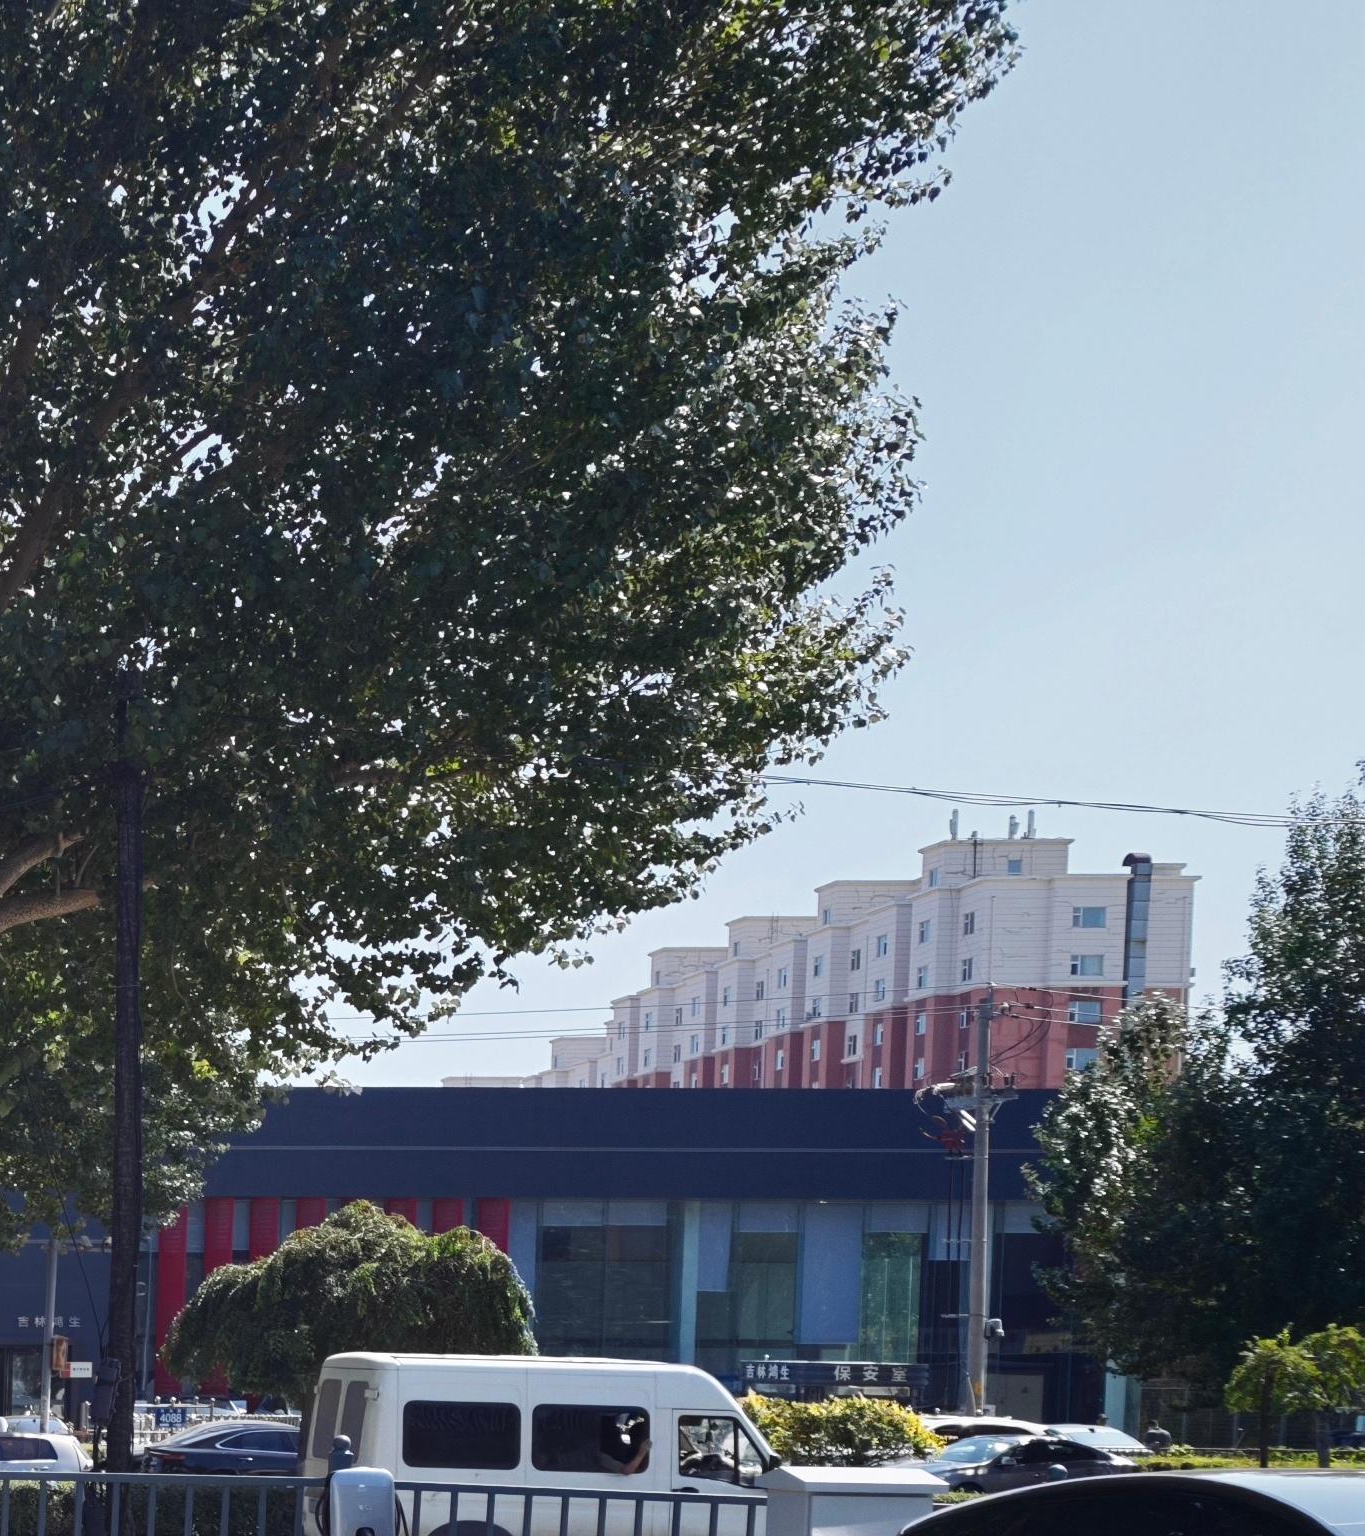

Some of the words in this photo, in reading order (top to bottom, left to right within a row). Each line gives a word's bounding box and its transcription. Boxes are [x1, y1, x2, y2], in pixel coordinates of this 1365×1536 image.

[746, 1364, 790, 1381] 吉林鸿生
[834, 1365, 908, 1383] 保安室
[159, 1413, 182, 1423] 4088
